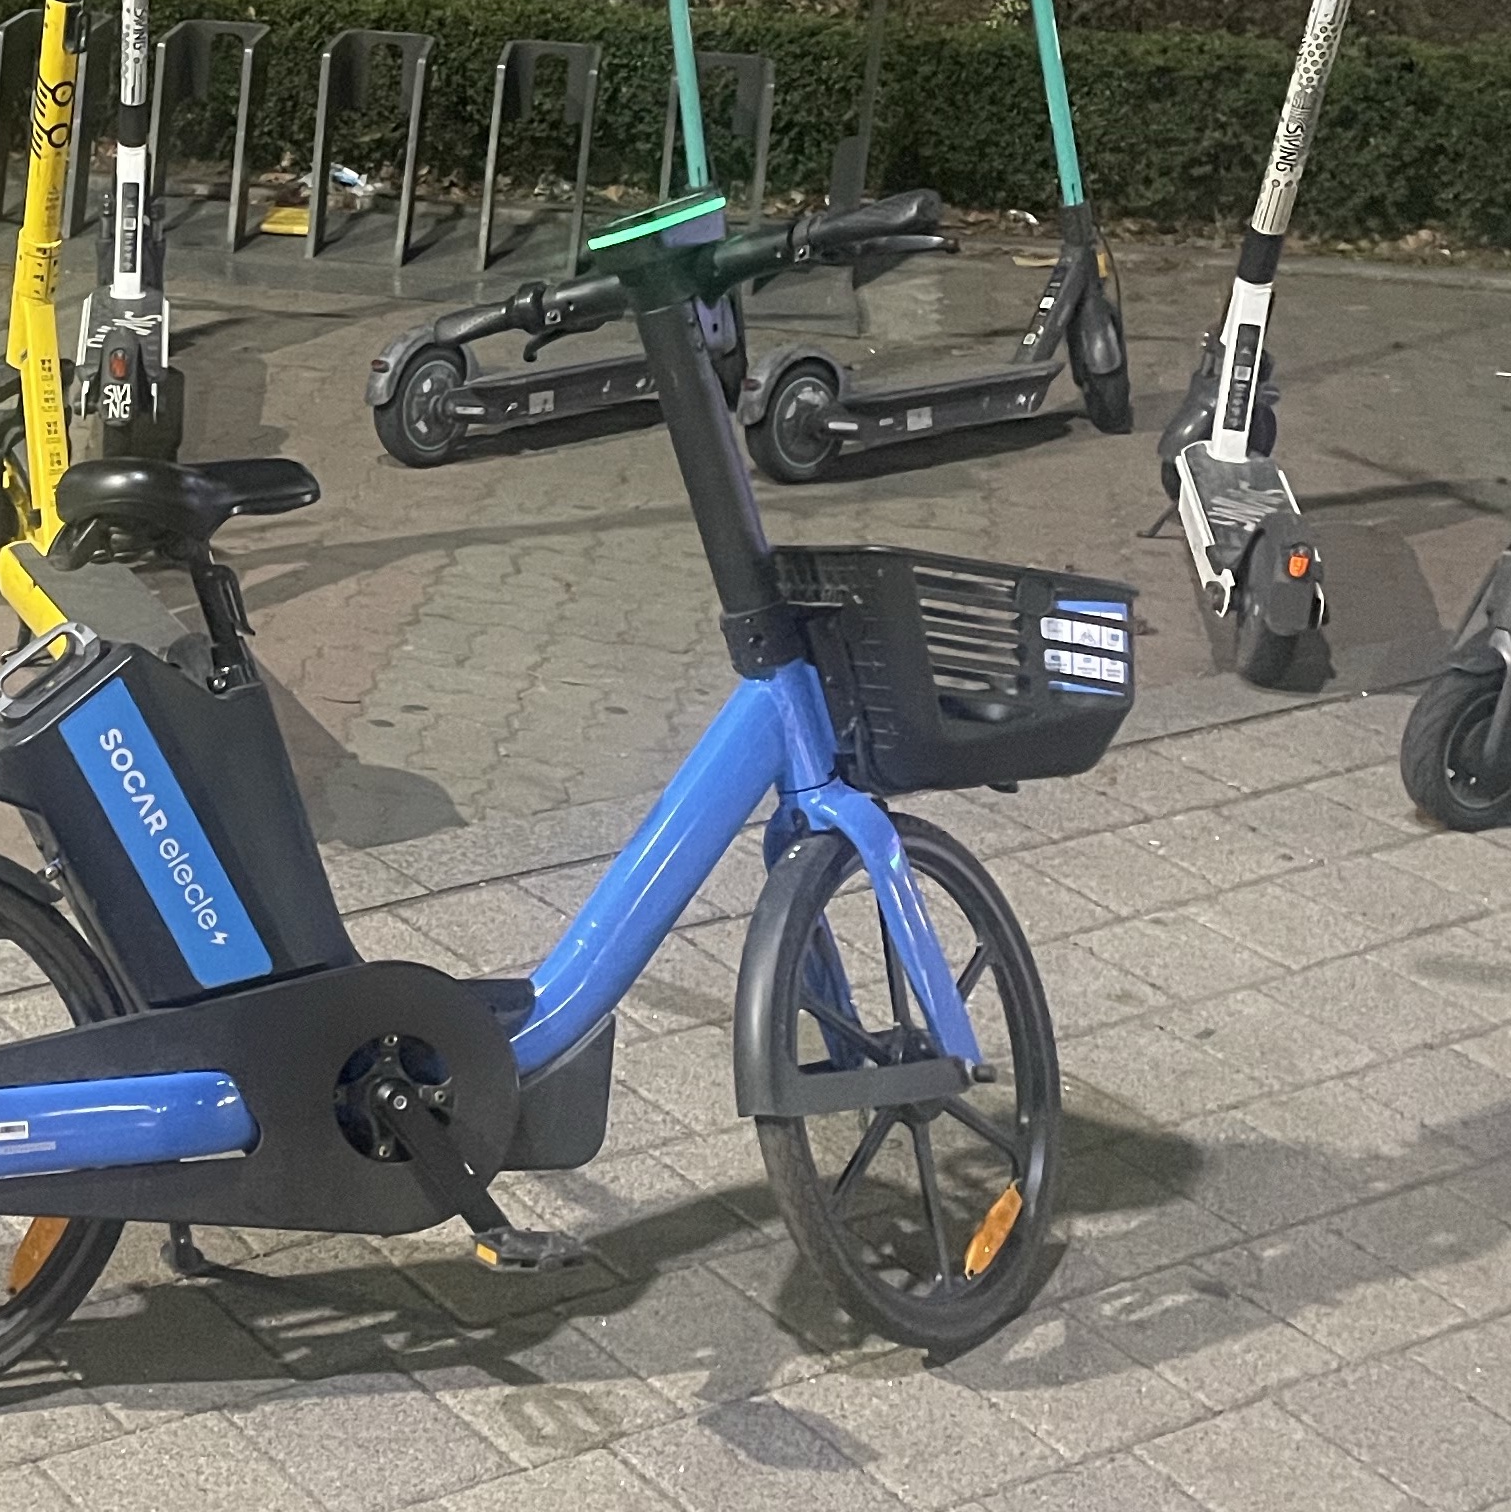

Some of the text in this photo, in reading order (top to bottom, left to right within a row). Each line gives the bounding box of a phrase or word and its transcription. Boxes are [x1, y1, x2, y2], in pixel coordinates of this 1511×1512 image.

[1275, 121, 1305, 173] SWING
[99, 728, 218, 930] SOCAR elecle
